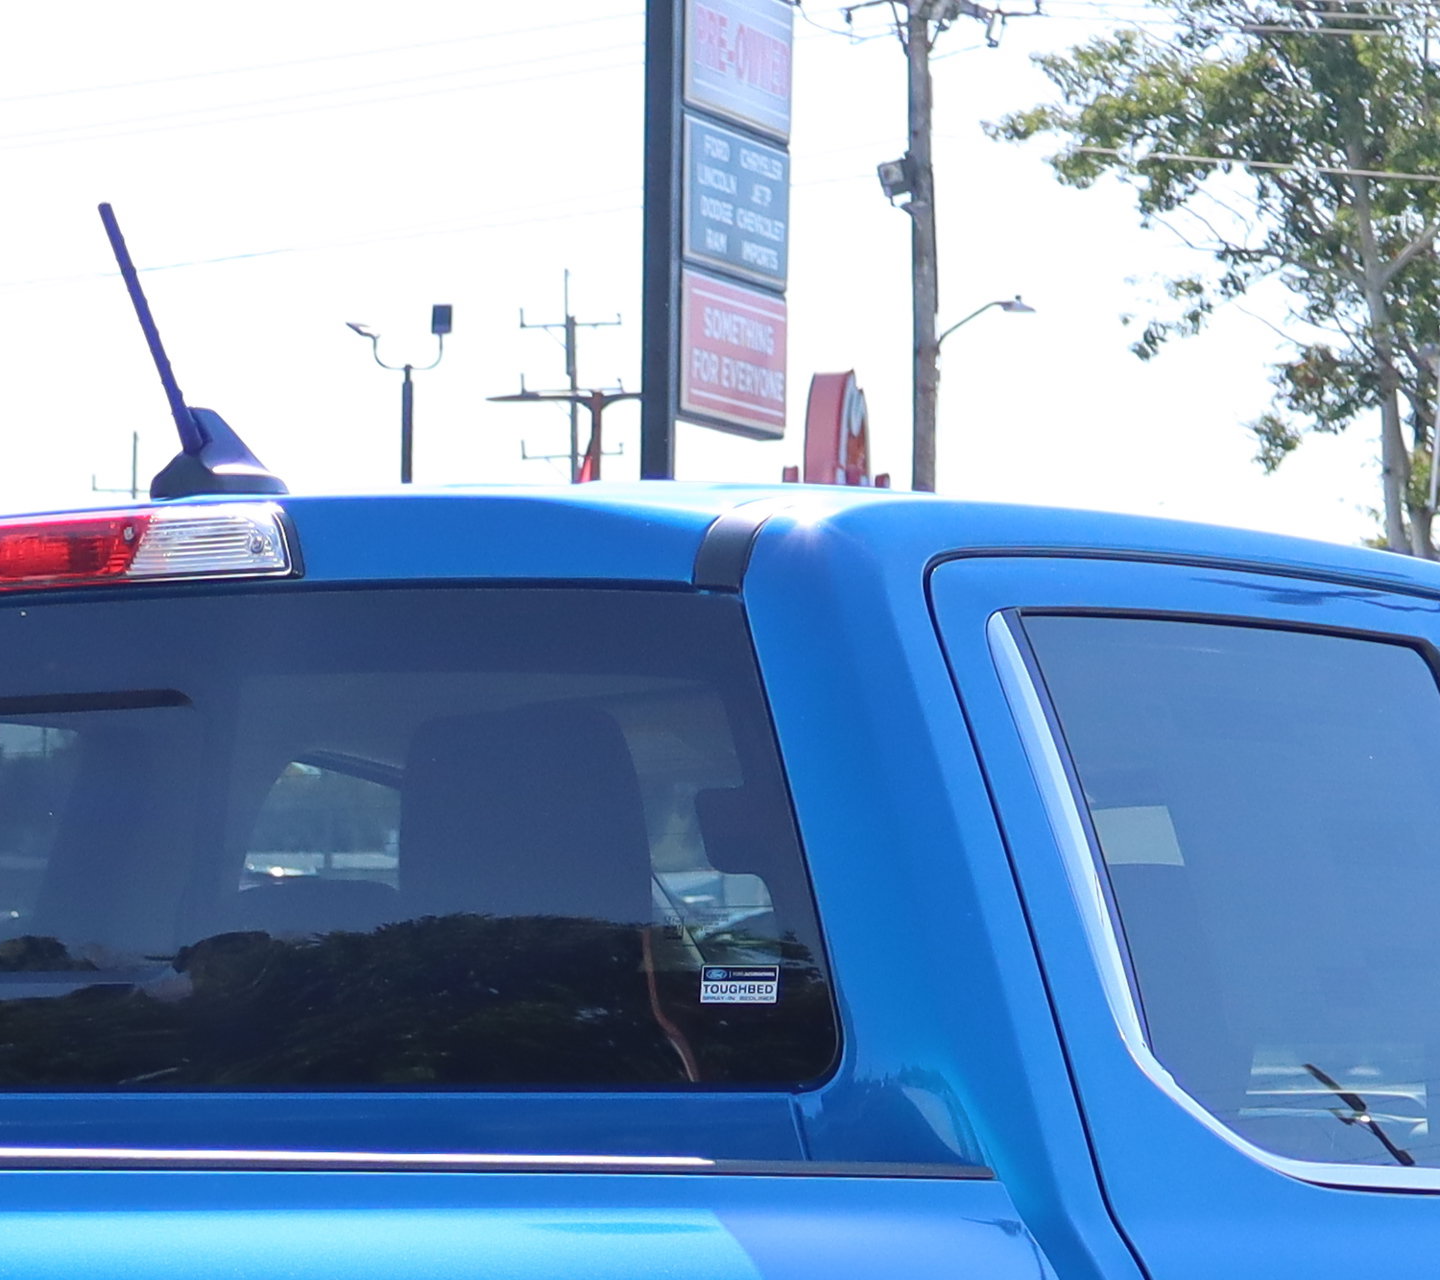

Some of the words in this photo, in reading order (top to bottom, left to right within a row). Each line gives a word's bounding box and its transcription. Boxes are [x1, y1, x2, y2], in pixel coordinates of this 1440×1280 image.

[696, 4, 790, 98] PRE-OWNED
[703, 306, 775, 356] SOMETHING
[692, 347, 719, 383] FOR
[721, 356, 784, 402] EVERYONE
[703, 984, 774, 994] TOUGHBED
